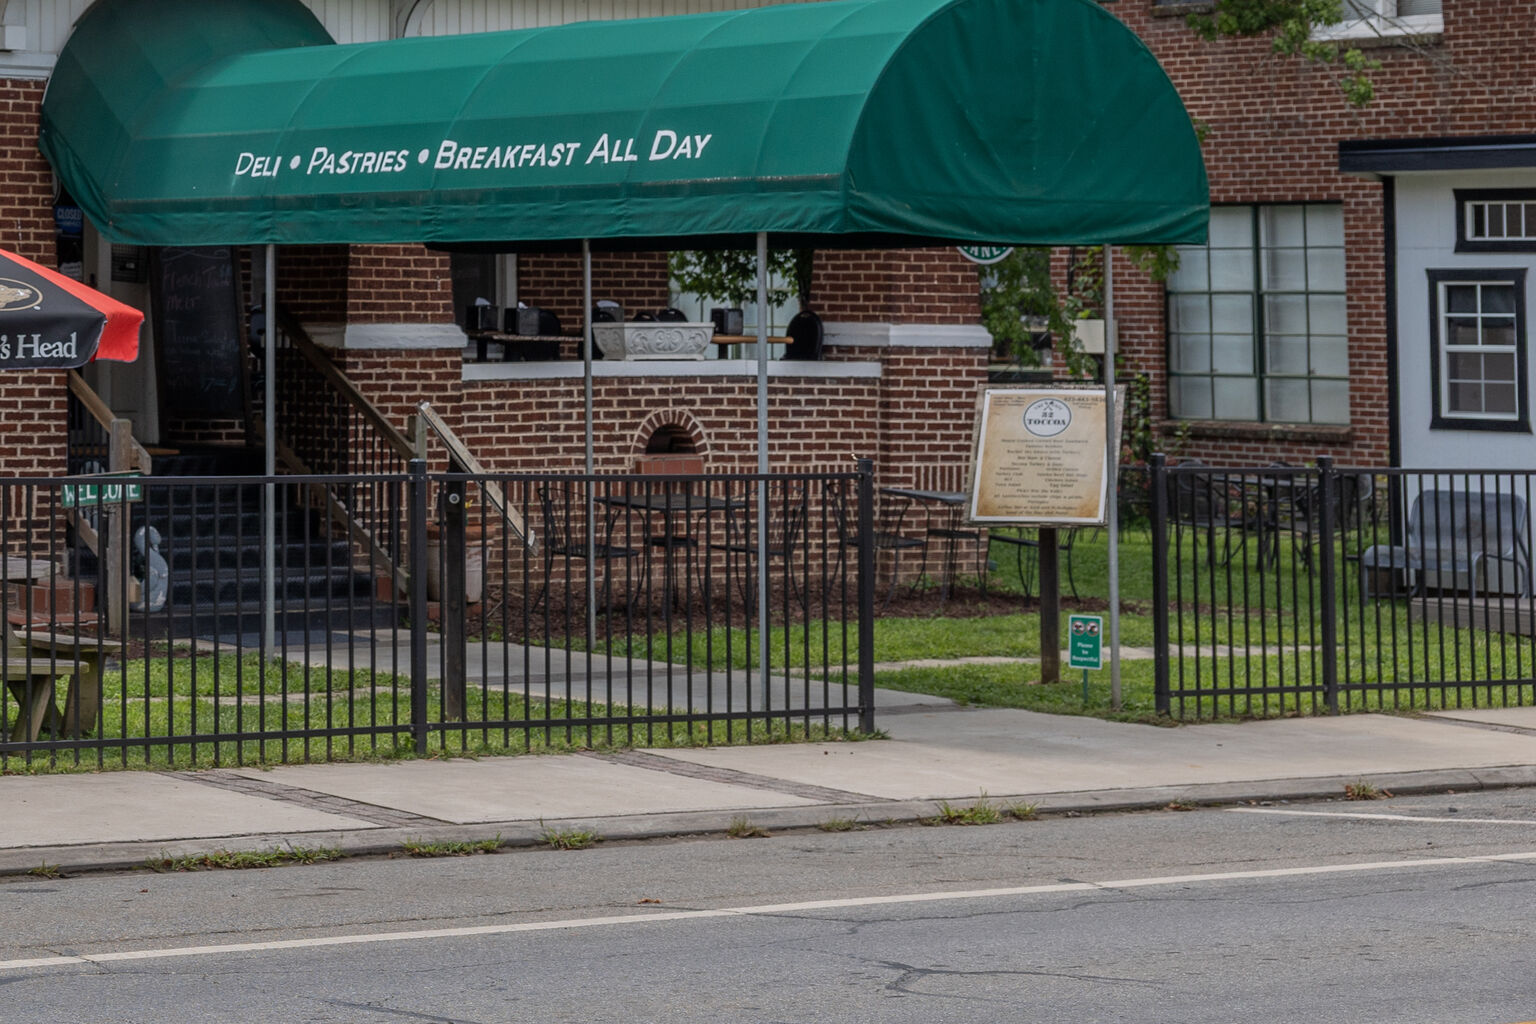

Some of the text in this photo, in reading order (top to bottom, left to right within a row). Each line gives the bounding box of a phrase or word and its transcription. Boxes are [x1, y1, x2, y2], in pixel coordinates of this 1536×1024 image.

[235, 129, 713, 177] DELI PASTRIES BREAKFAST ALL DAY
[15, 331, 78, 359] Head
[1026, 418, 1066, 426] TOCCOA
